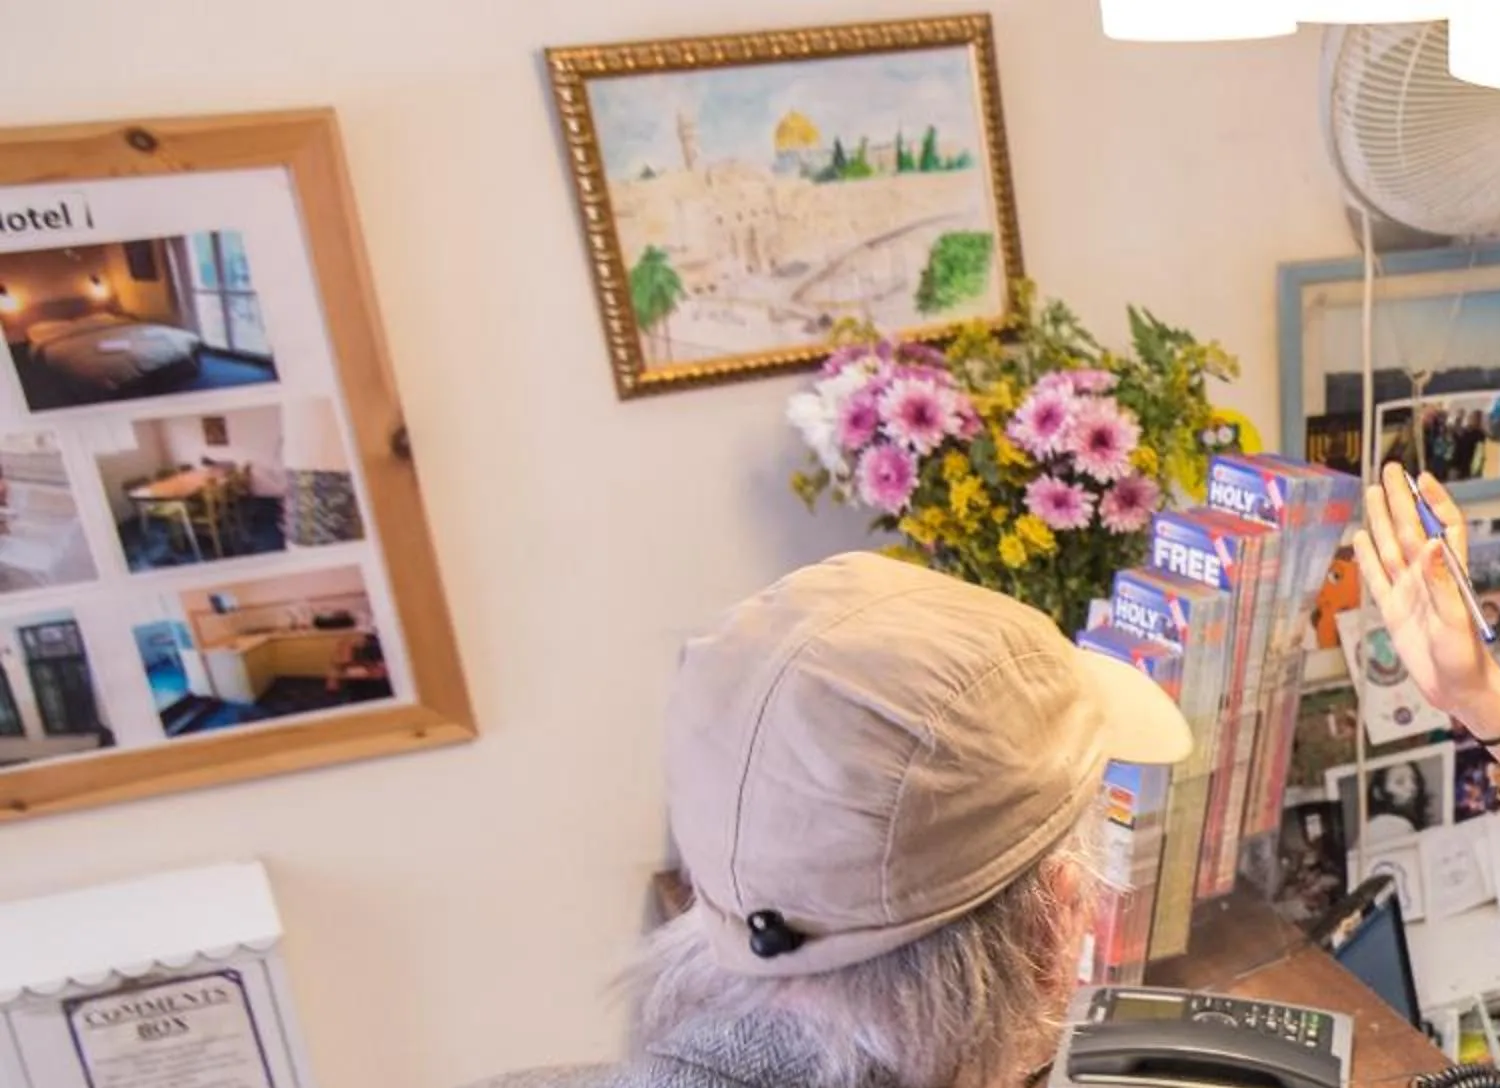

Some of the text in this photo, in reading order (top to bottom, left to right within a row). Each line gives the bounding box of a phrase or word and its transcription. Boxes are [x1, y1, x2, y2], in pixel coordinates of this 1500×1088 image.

[0, 201, 72, 232] otel
[1210, 481, 1255, 512] HOLY
[1153, 537, 1221, 588] FREE
[1116, 596, 1158, 630] HOLY
[84, 988, 229, 1028] COMMENTS
[136, 1015, 190, 1041] BOX
